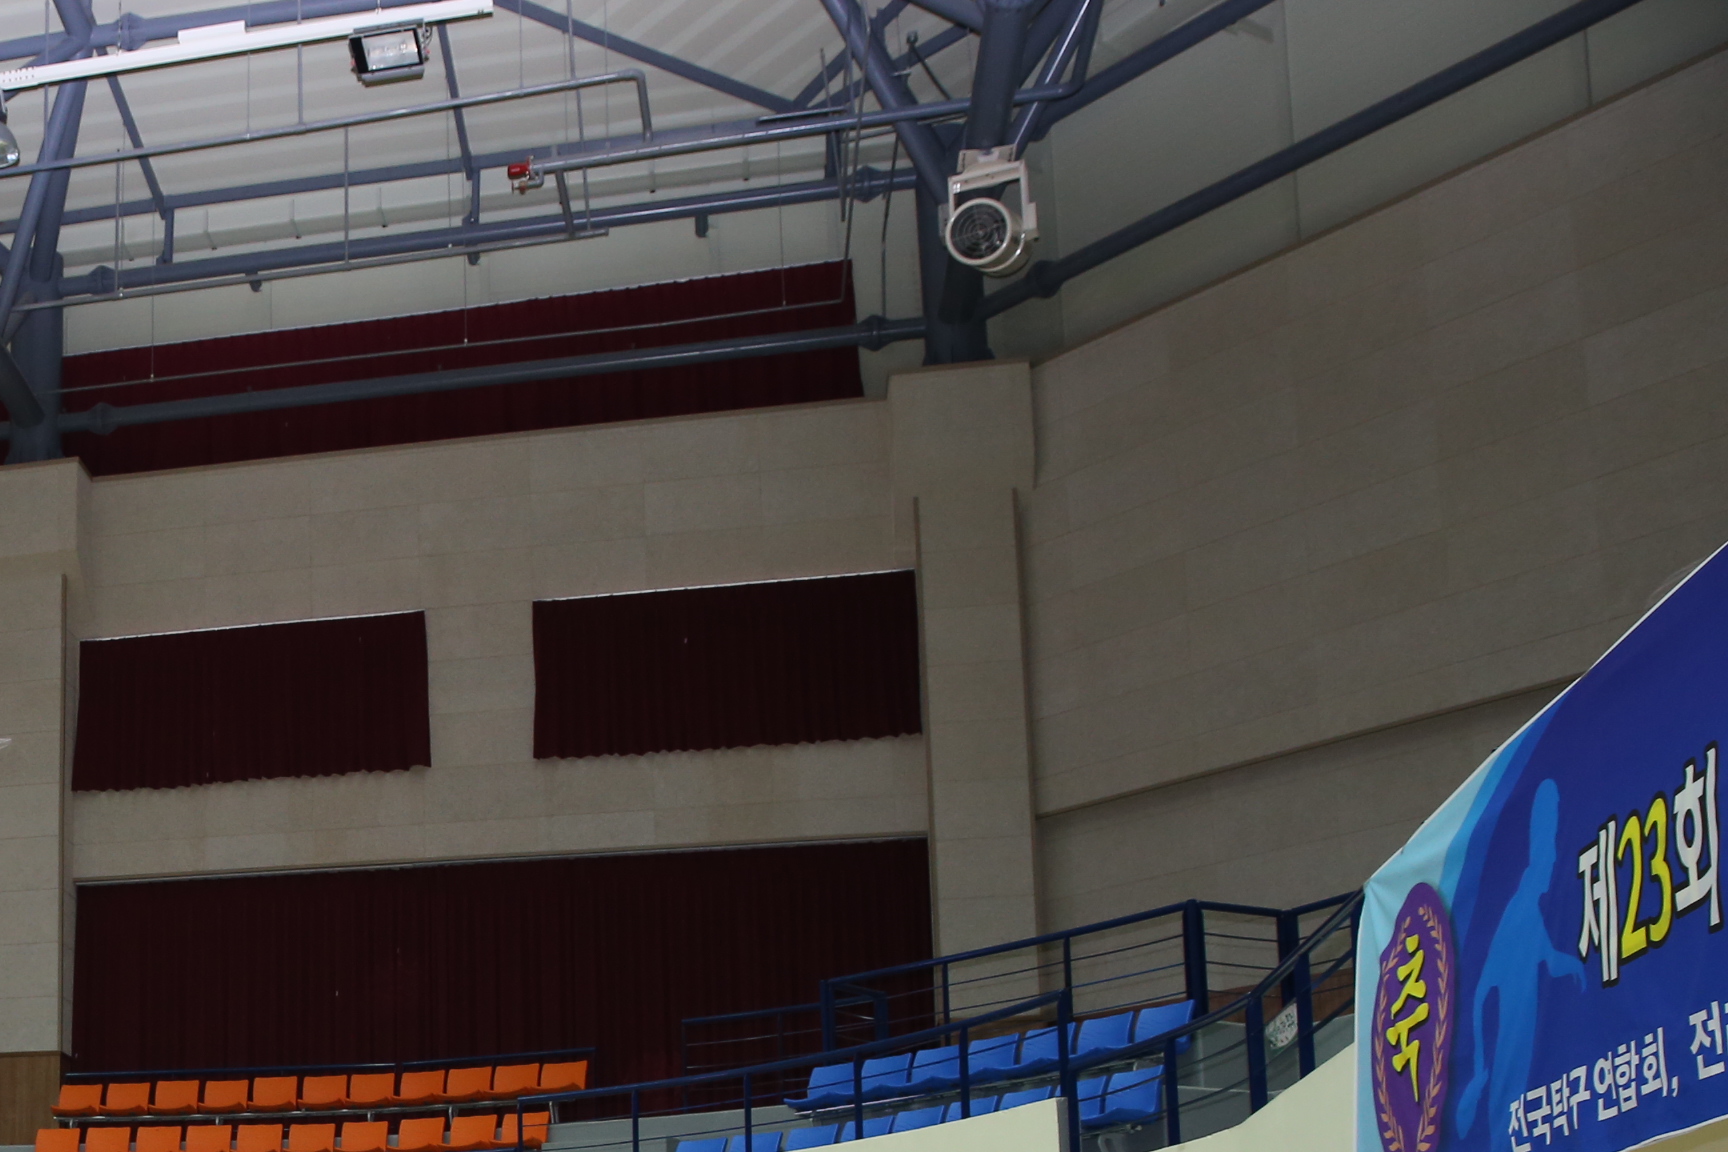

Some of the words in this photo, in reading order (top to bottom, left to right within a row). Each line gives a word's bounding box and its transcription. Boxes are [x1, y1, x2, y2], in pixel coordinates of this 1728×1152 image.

[1578, 747, 1721, 983] 제23회
[1386, 934, 1430, 1102] 축
[1689, 1000, 1728, 1080] 전
